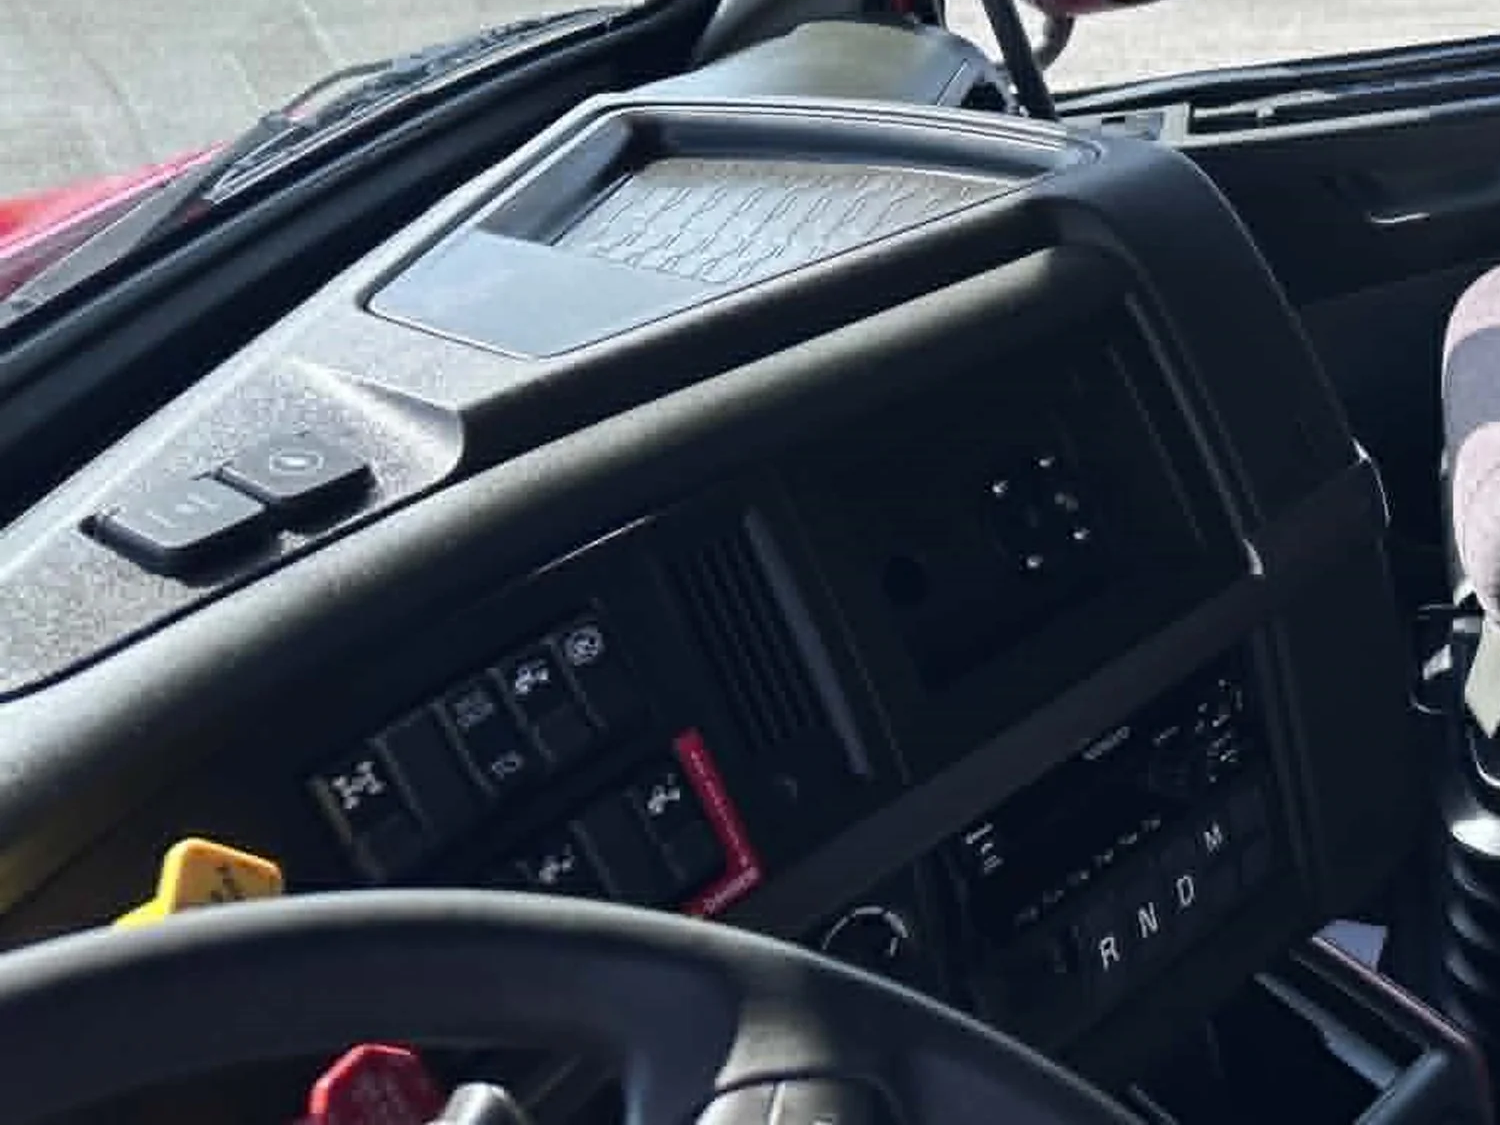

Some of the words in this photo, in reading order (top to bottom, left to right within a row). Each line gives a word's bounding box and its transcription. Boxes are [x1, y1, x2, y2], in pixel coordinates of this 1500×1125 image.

[1203, 820, 1224, 856] M
[1099, 935, 1121, 972] R
[1136, 901, 1161, 939] N
[1175, 874, 1197, 908] D
